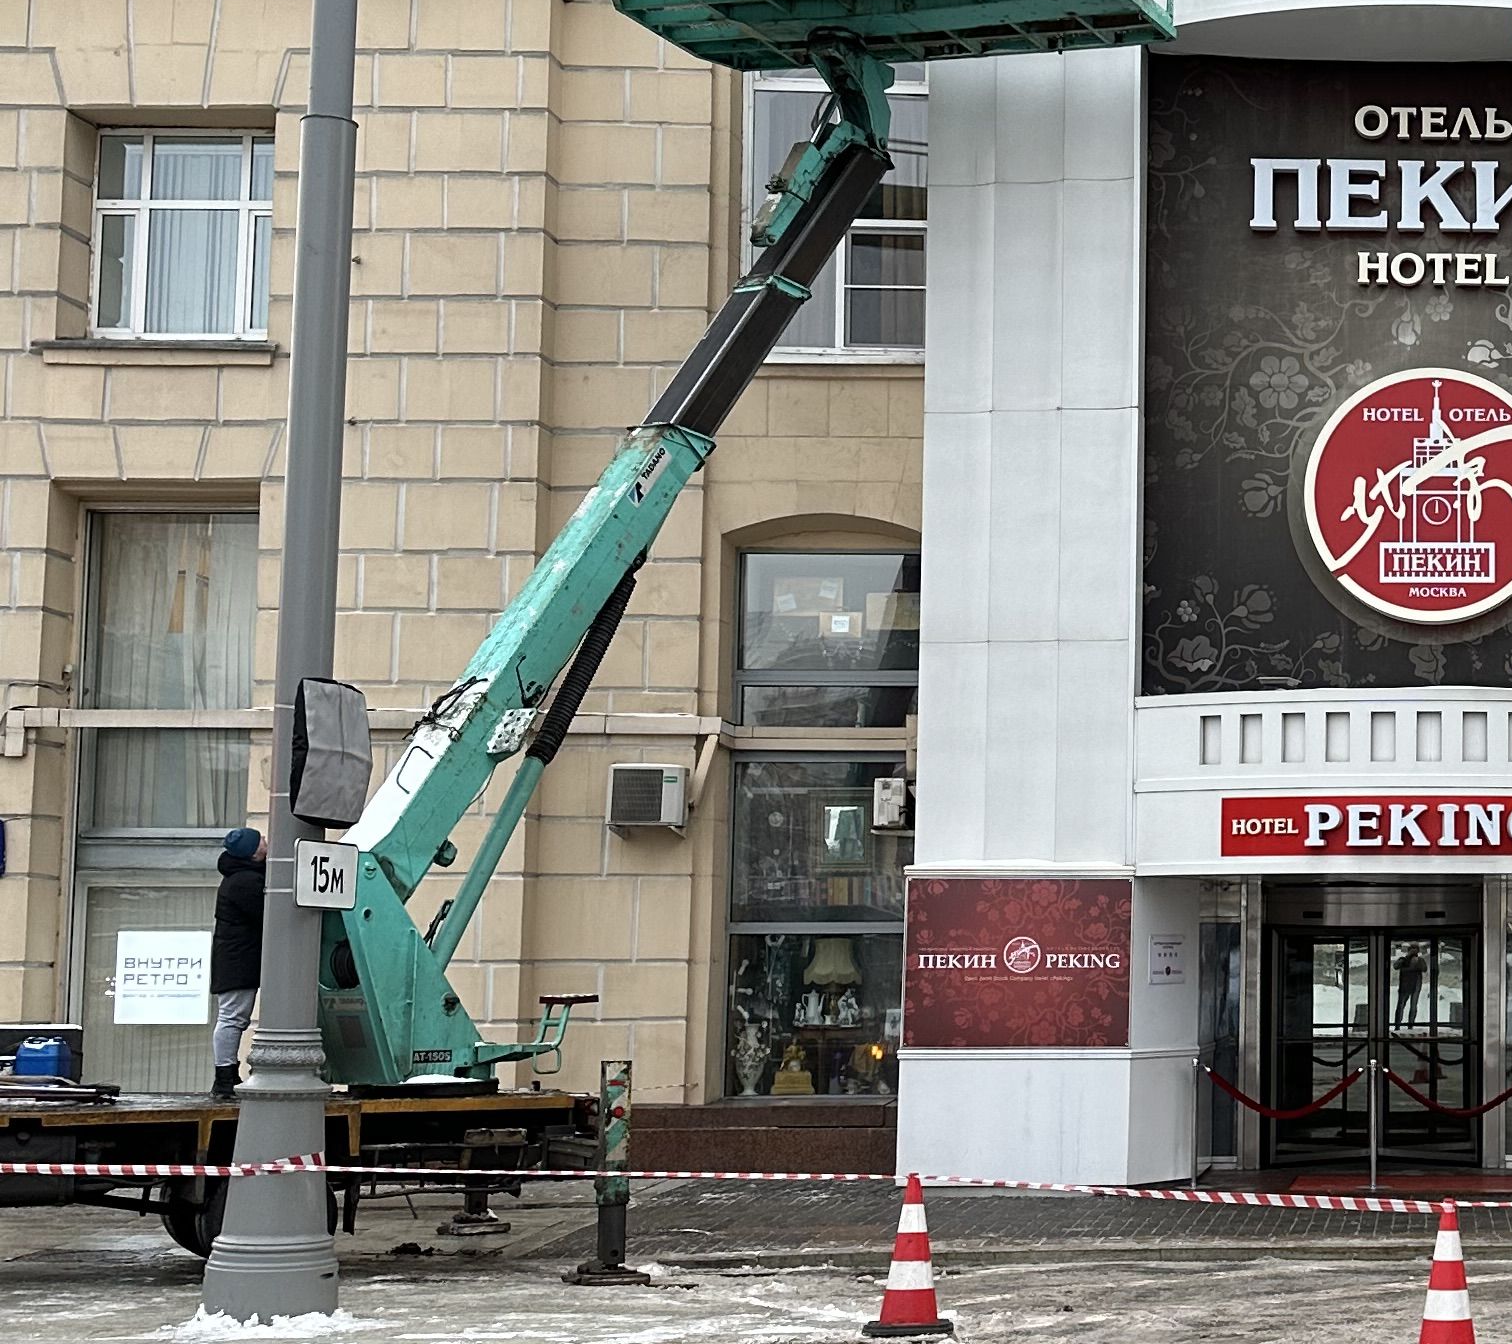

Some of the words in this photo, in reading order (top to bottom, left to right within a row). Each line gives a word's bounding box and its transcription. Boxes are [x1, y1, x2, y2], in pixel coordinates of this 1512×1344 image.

[1355, 105, 1512, 141] ОТЕЛЬ
[1357, 252, 1510, 286] HOTEL
[1363, 407, 1424, 422] HOTEL
[1449, 408, 1511, 422] ОТЕЛЬ
[641, 447, 666, 479] TADANO
[1392, 553, 1481, 572] ПЕКИН
[1408, 587, 1467, 598] МОСКВА
[1231, 818, 1299, 836] HOTEL
[124, 957, 202, 969] ВНУТРИ
[918, 954, 997, 969] ПЕКИН
[1045, 953, 1120, 969] PEKING
[123, 974, 188, 985] РЕТРО
